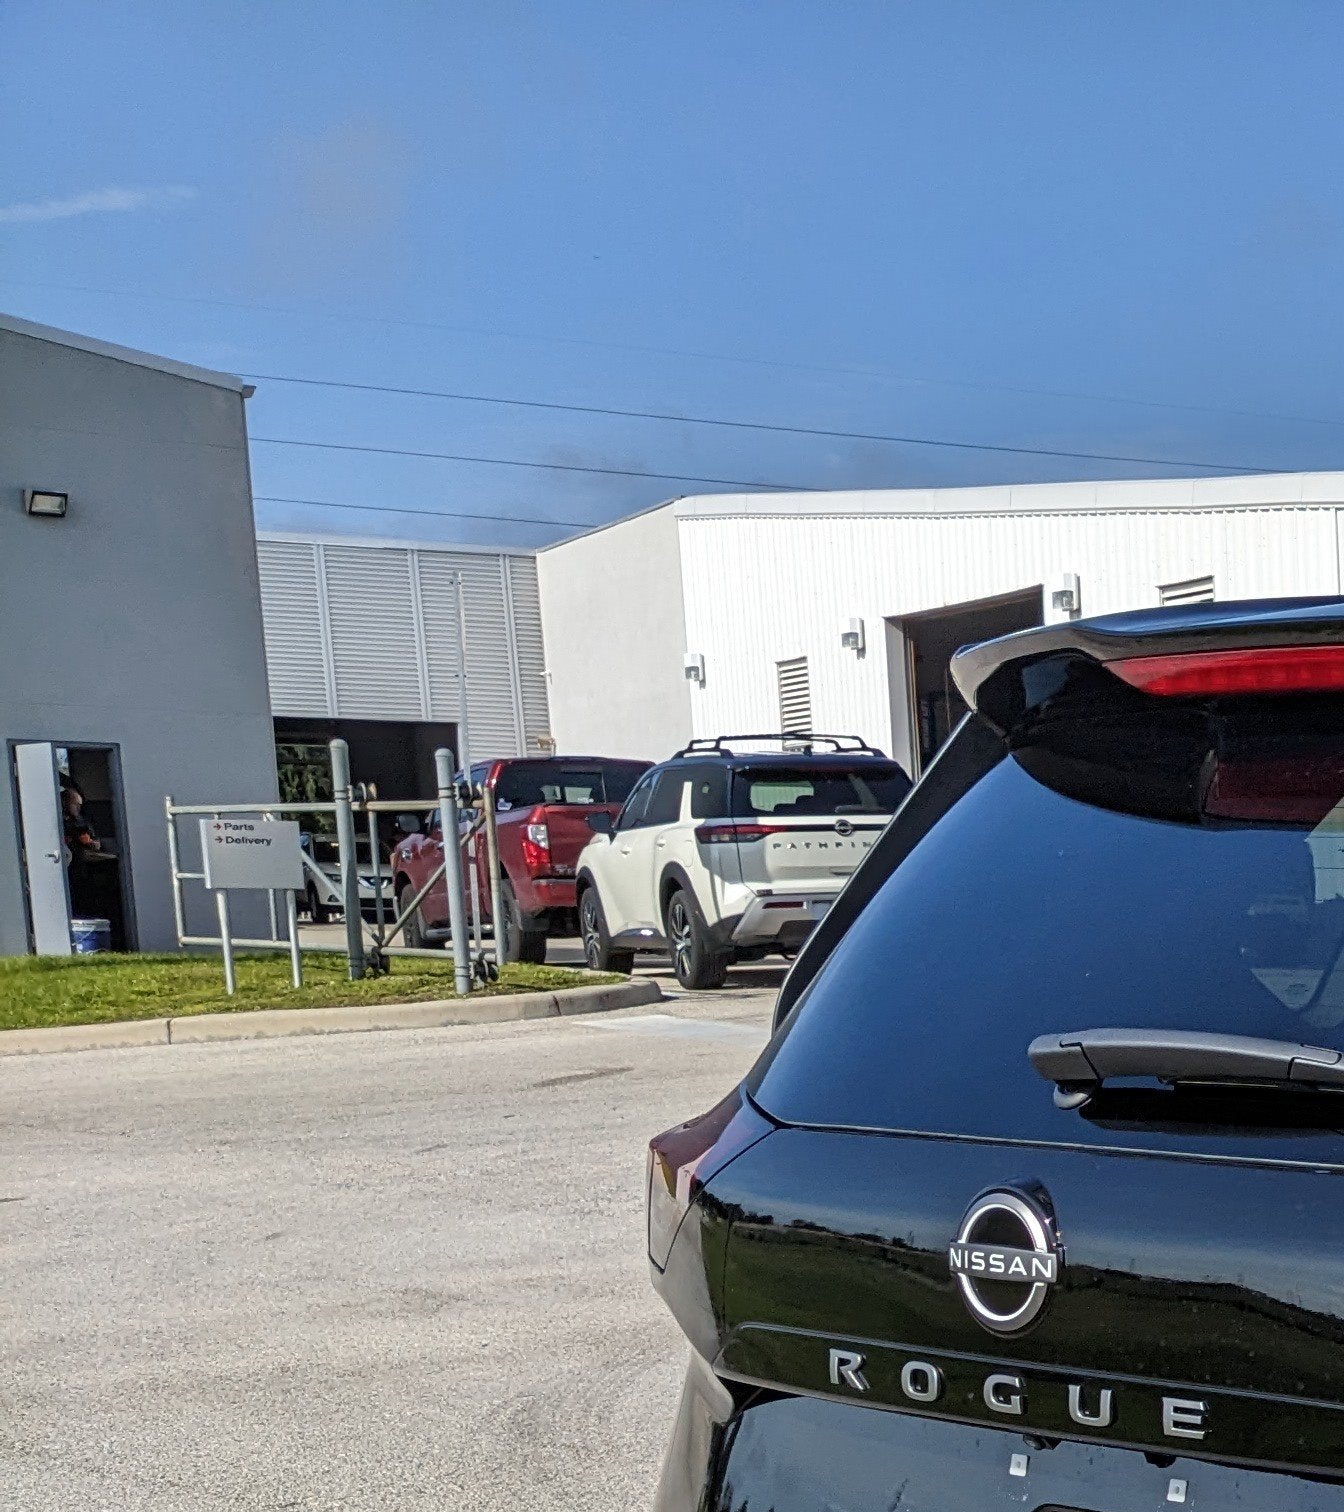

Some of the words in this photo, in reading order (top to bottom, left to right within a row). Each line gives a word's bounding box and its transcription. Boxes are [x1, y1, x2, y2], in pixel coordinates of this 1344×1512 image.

[224, 823, 255, 831] Parts
[226, 836, 272, 846] Delivery
[949, 1247, 1052, 1278] NISSAN
[829, 1347, 1209, 1441] ROGUE
